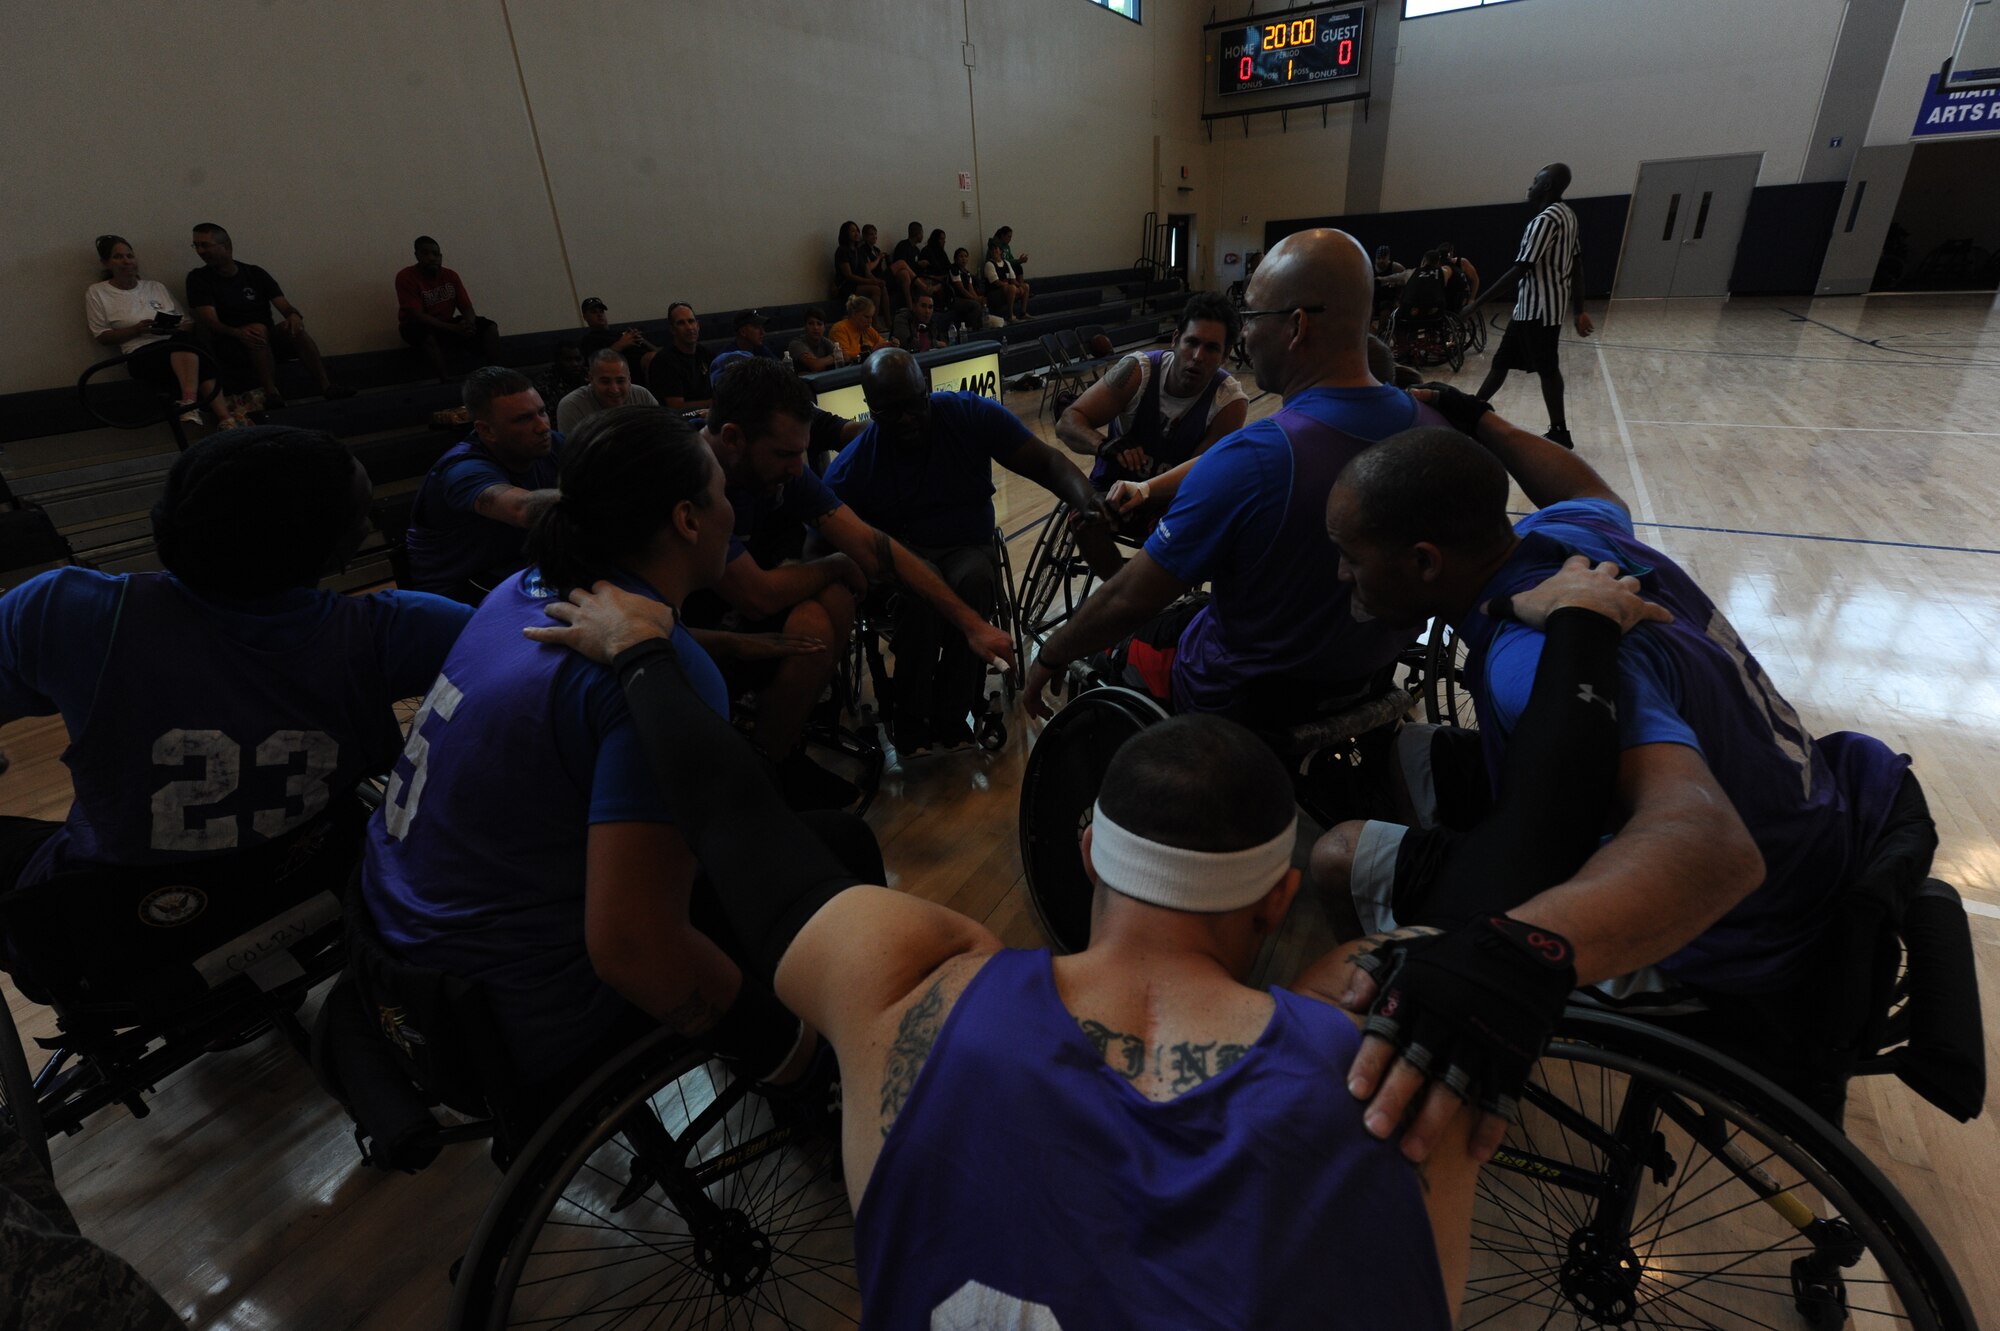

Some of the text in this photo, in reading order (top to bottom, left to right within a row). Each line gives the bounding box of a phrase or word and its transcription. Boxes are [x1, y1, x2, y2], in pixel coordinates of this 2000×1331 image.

[1321, 24, 1359, 43] GUEST
[1224, 43, 1255, 59] HOME
[1338, 39, 1352, 65] 0
[1239, 56, 1252, 81] 0
[1287, 59, 1293, 81] 1
[1309, 68, 1338, 80] BONUS
[1236, 80, 1263, 91] BONUS
[1925, 103, 1985, 124] ARTS
[385, 672, 464, 842] 5
[150, 728, 339, 851] 23
